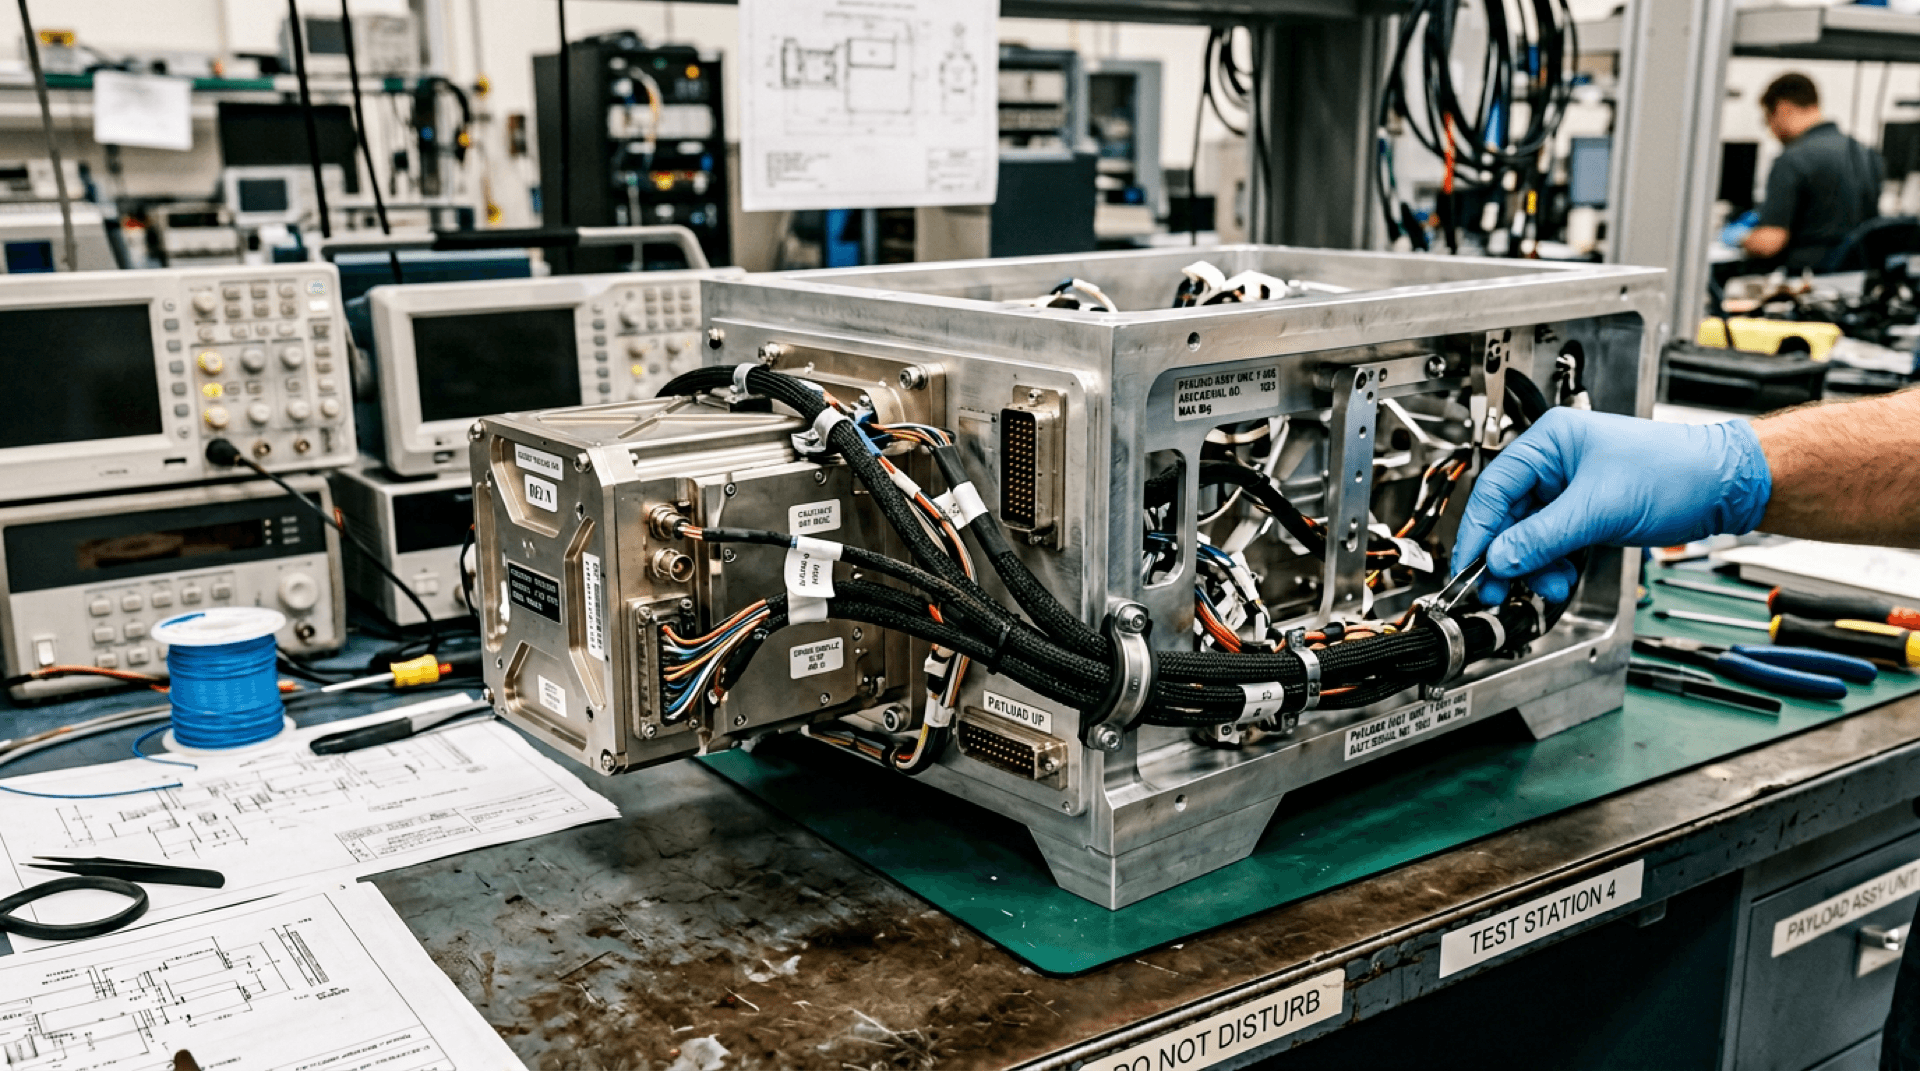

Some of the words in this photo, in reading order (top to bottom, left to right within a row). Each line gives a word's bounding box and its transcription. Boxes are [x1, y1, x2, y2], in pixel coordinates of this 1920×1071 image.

[1032, 712, 1045, 726] UP
[1470, 916, 1520, 954] TEST
[1524, 884, 1602, 934] STATION
[1606, 879, 1616, 899] 4
[1786, 899, 1850, 943] PAYLOAD
[1852, 881, 1886, 911] ASSY
[1888, 868, 1918, 896] UNIT
[1159, 1030, 1211, 1071] NOT
[1218, 989, 1320, 1050] DISTURB
